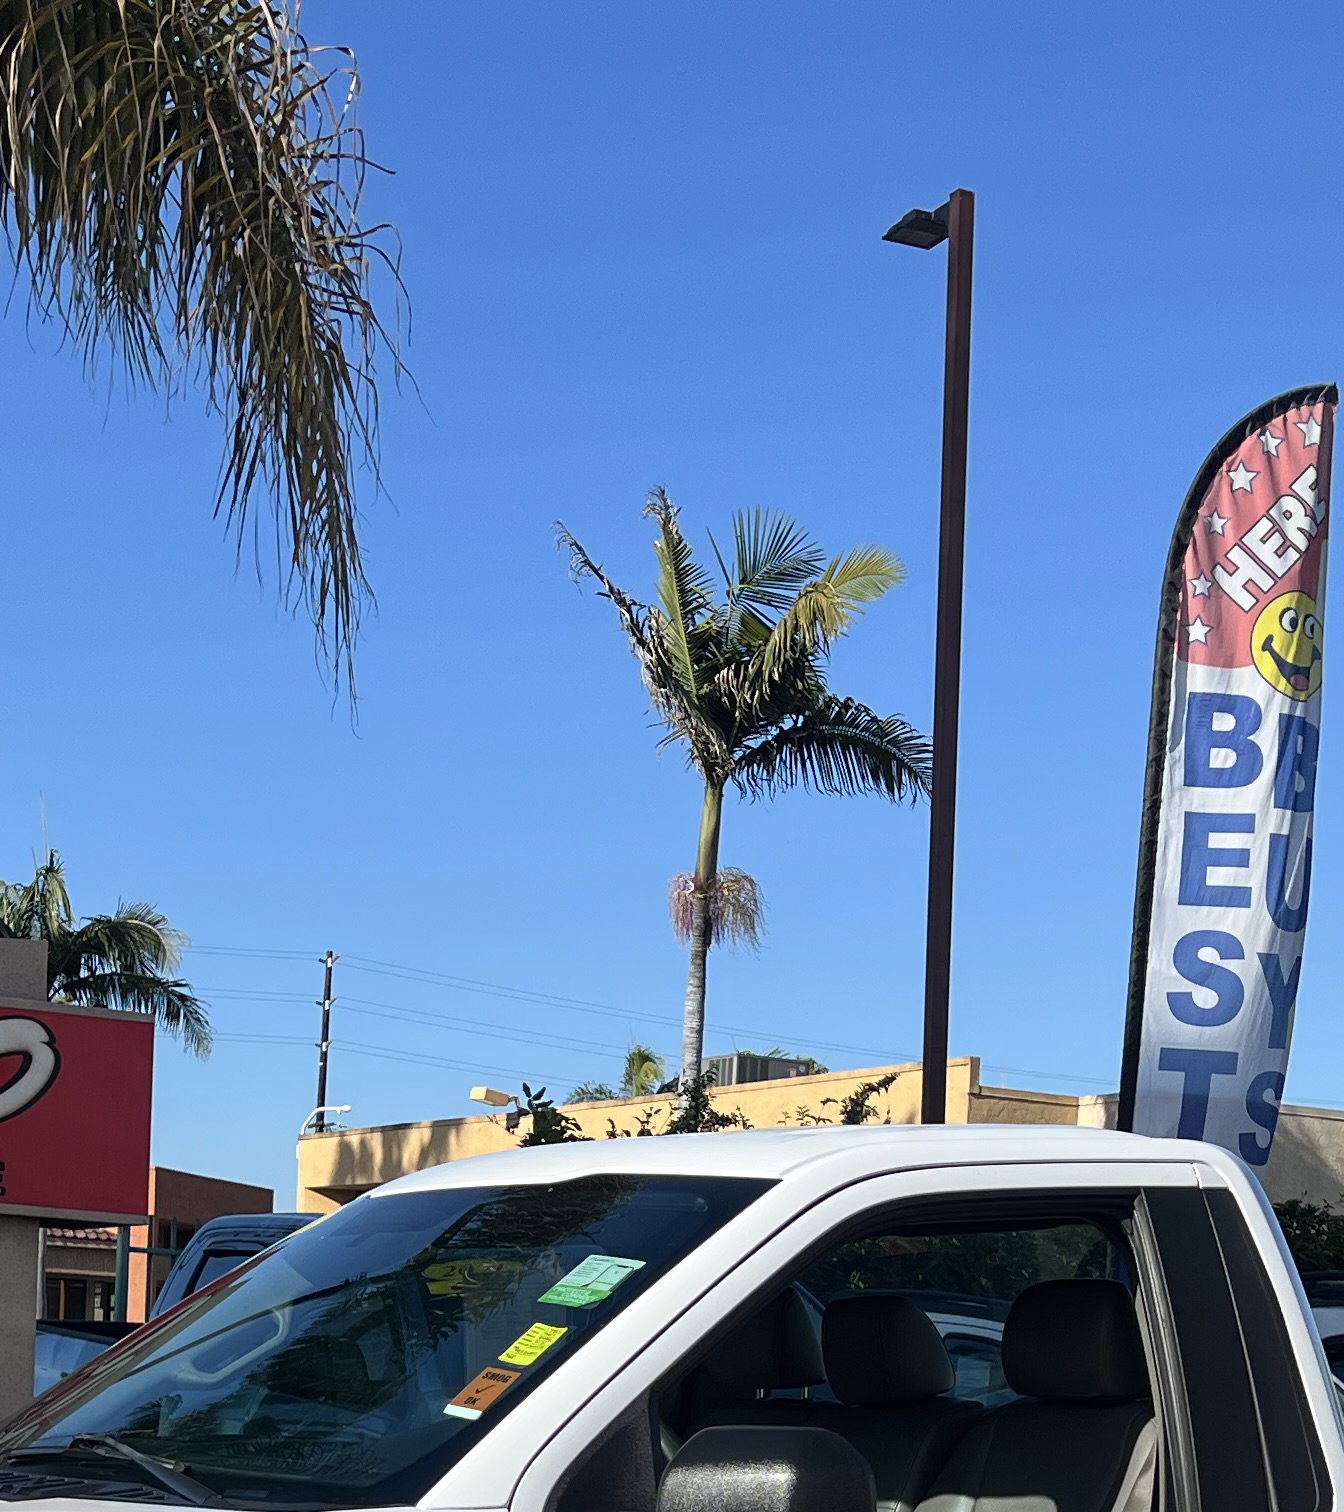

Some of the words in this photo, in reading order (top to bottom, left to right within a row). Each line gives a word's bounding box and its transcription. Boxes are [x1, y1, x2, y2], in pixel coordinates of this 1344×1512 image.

[1210, 463, 1326, 614] HERE
[1157, 691, 1264, 1144] BEST
[1238, 712, 1321, 1168] BUYS
[481, 1371, 513, 1384] SMOG
